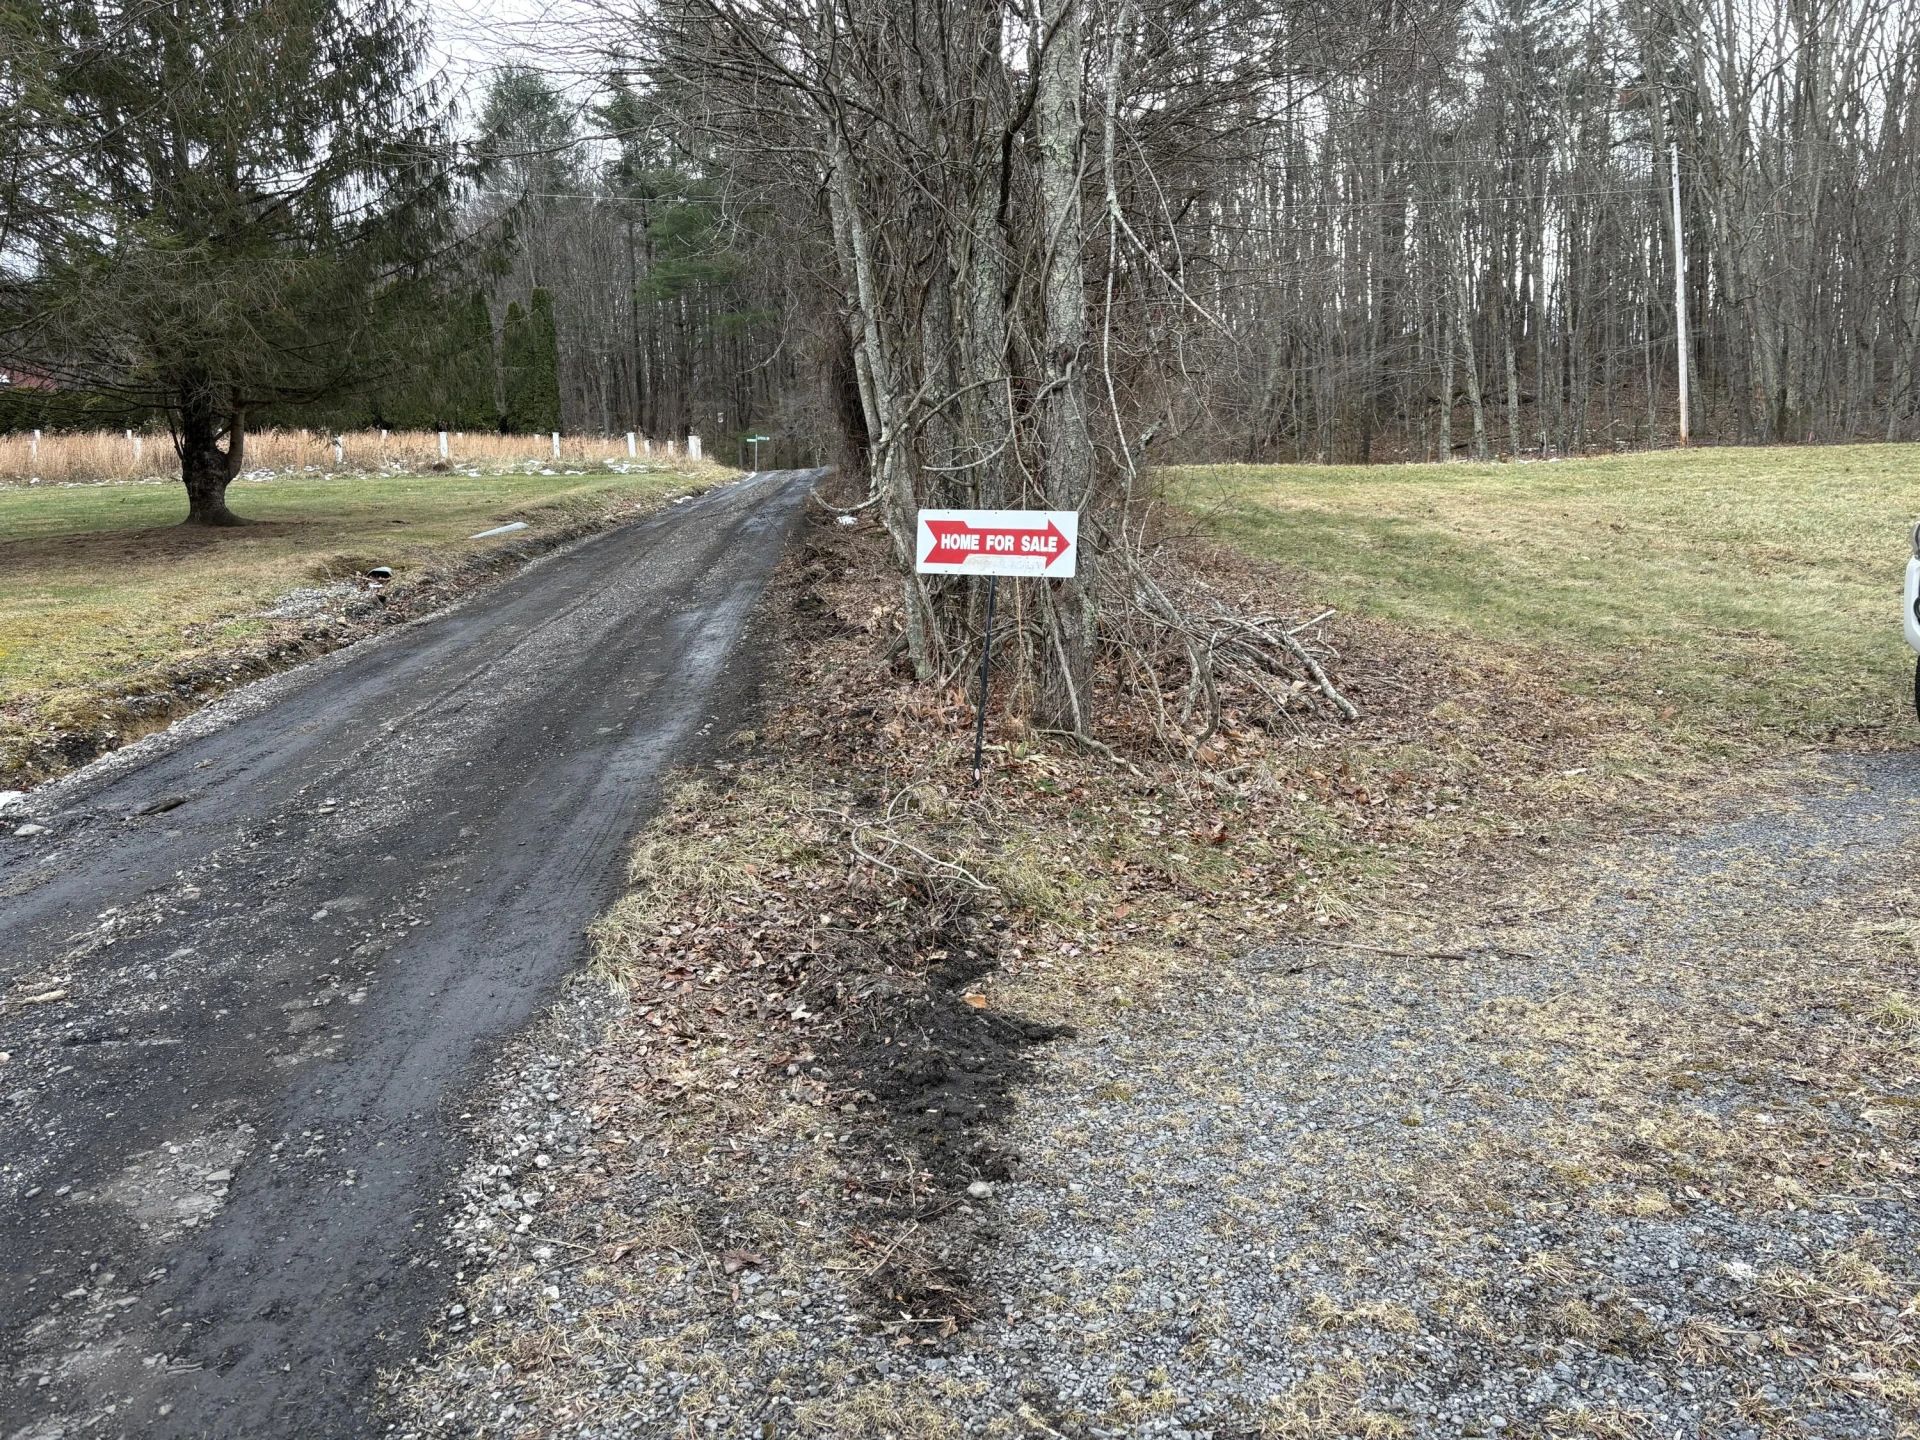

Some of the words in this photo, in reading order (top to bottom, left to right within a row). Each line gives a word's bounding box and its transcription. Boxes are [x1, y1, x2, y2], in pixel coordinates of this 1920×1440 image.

[941, 533, 980, 550] HOME
[985, 535, 1014, 551] FOR
[1021, 536, 1058, 552] SALE
